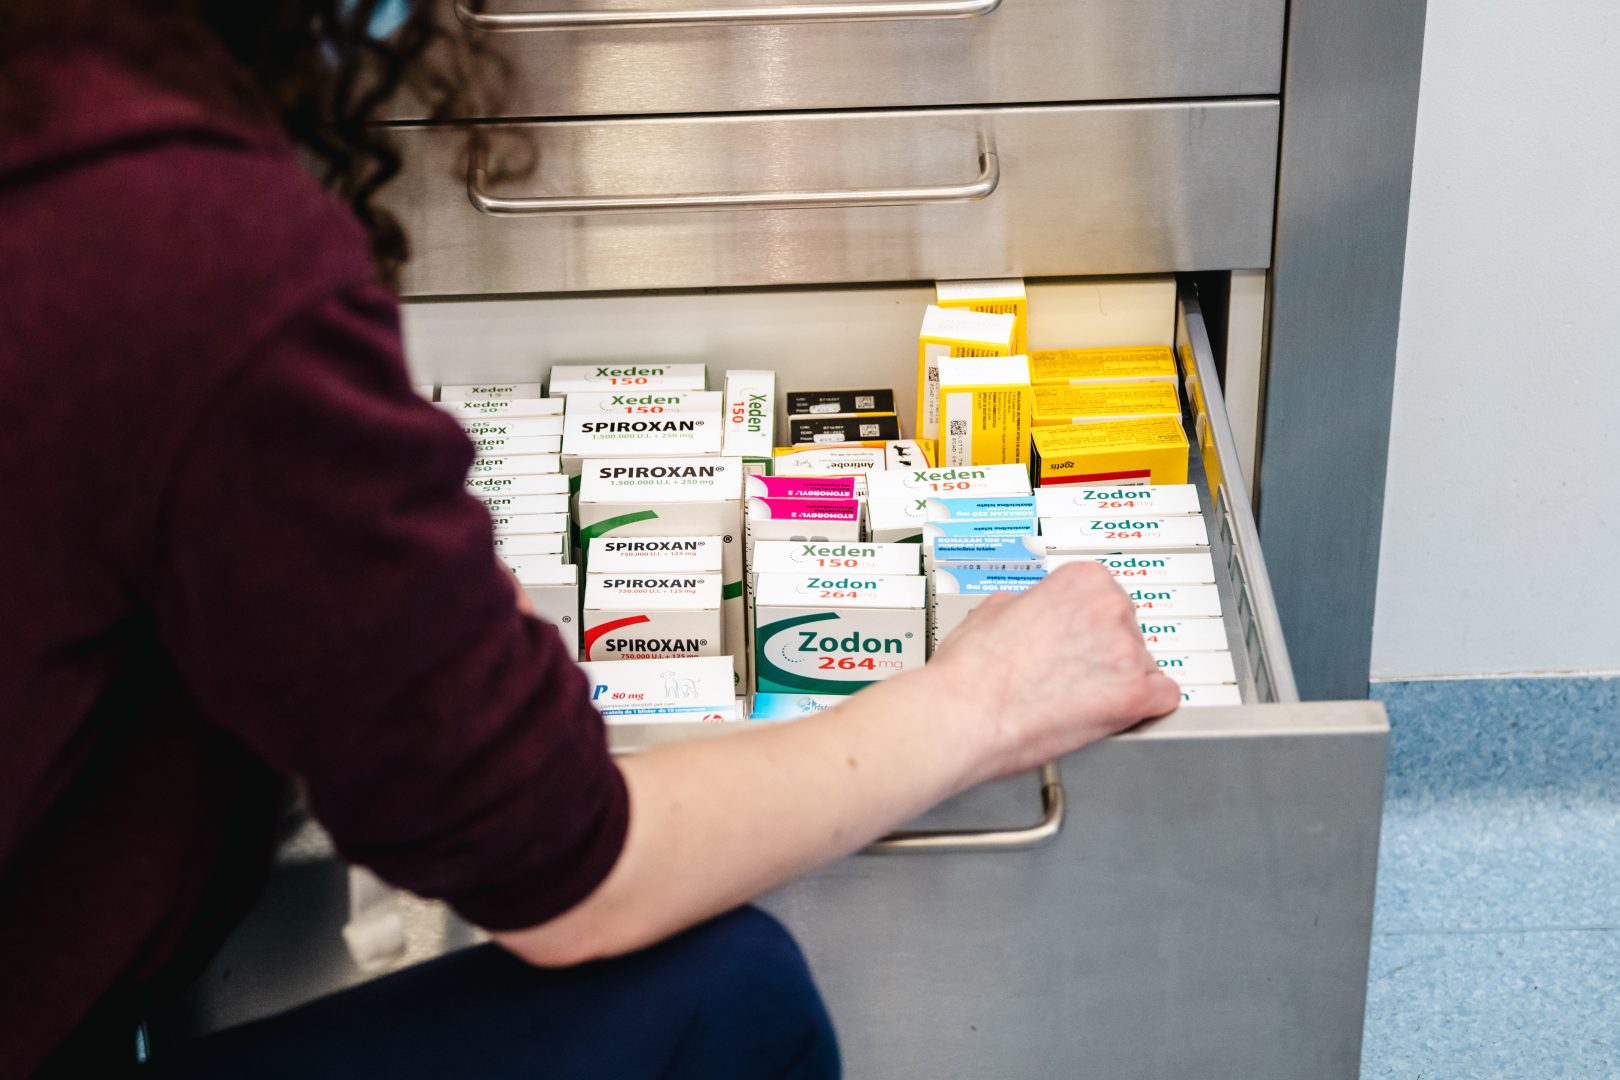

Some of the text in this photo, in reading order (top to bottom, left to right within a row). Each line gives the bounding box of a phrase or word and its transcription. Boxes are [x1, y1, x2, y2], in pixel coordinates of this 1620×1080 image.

[596, 366, 664, 377] Xeden
[608, 377, 648, 385] 150
[610, 395, 680, 405] Xeden
[624, 406, 664, 414] 150
[732, 401, 745, 423] 150
[748, 394, 767, 433] Xeden
[464, 427, 507, 435] Xeden
[1050, 461, 1075, 471] zoetis
[599, 466, 725, 479] SPIROXAN®
[913, 469, 985, 482] Xeden
[465, 478, 512, 486] Xeden
[929, 481, 971, 491] 150
[1083, 490, 1151, 500] Zodon
[1097, 500, 1135, 508] 264
[1090, 520, 1159, 530] Zodon
[1105, 531, 1142, 539] 264
[802, 544, 875, 557] Xeden
[816, 558, 858, 567] 150
[806, 578, 877, 589] Zodon
[819, 590, 857, 598] 264
[1129, 590, 1171, 600] don
[605, 638, 708, 652] SPIROXAN®
[818, 656, 876, 670] 264
[611, 692, 626, 700] 80
[628, 692, 644, 700] mg
